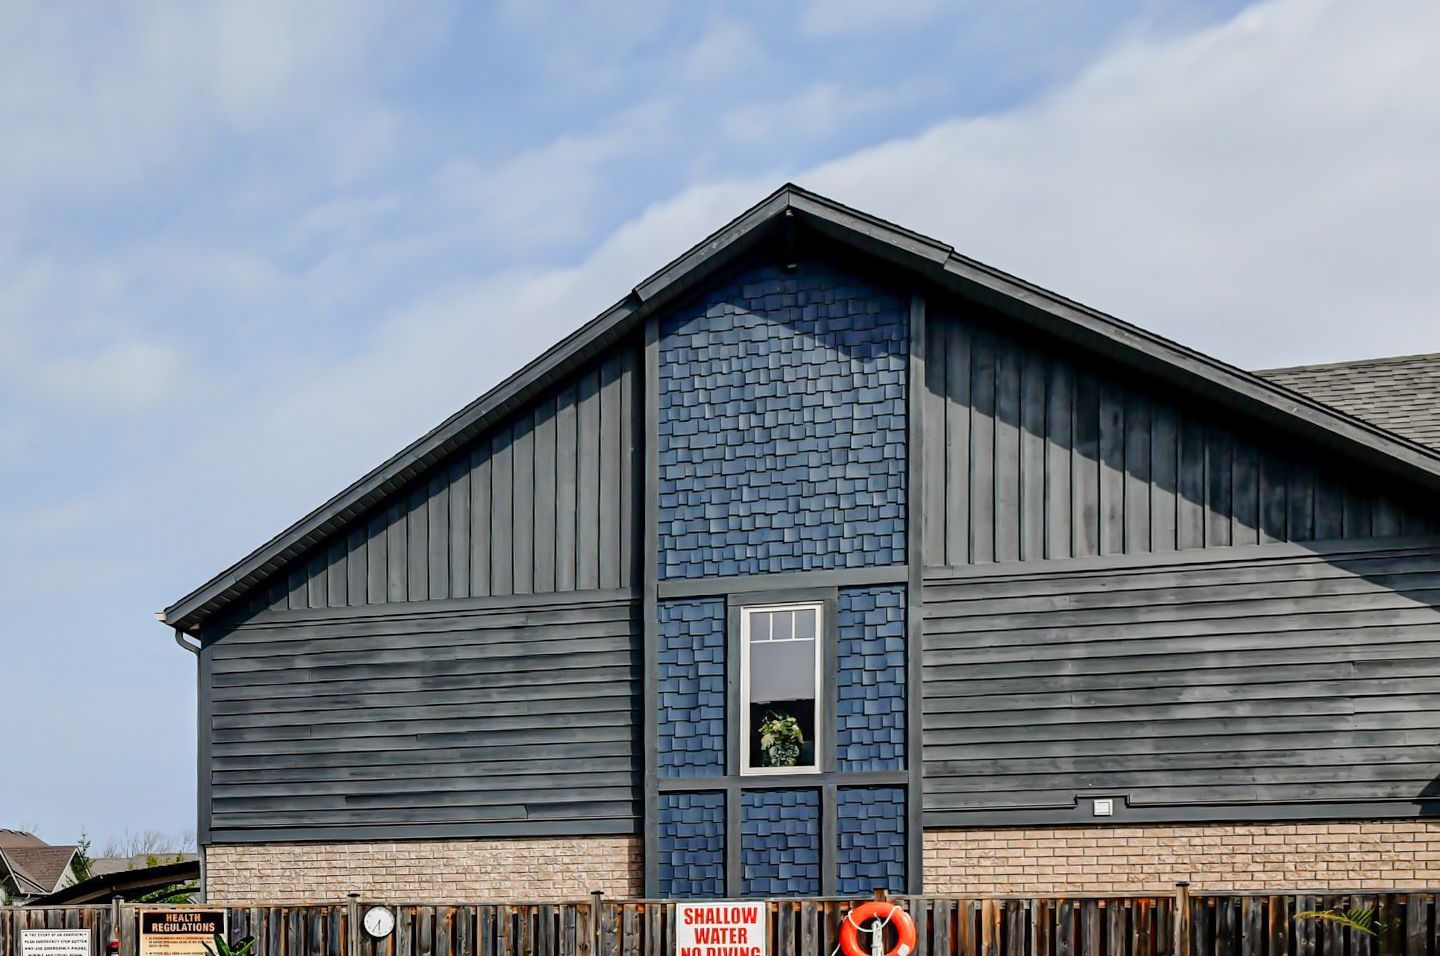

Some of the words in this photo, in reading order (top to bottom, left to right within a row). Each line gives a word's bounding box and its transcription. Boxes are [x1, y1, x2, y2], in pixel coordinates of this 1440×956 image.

[165, 913, 201, 922] HEALTH
[683, 907, 758, 925] SHALLOW
[151, 922, 216, 932] REGULATIONS
[694, 927, 748, 945] WATER
